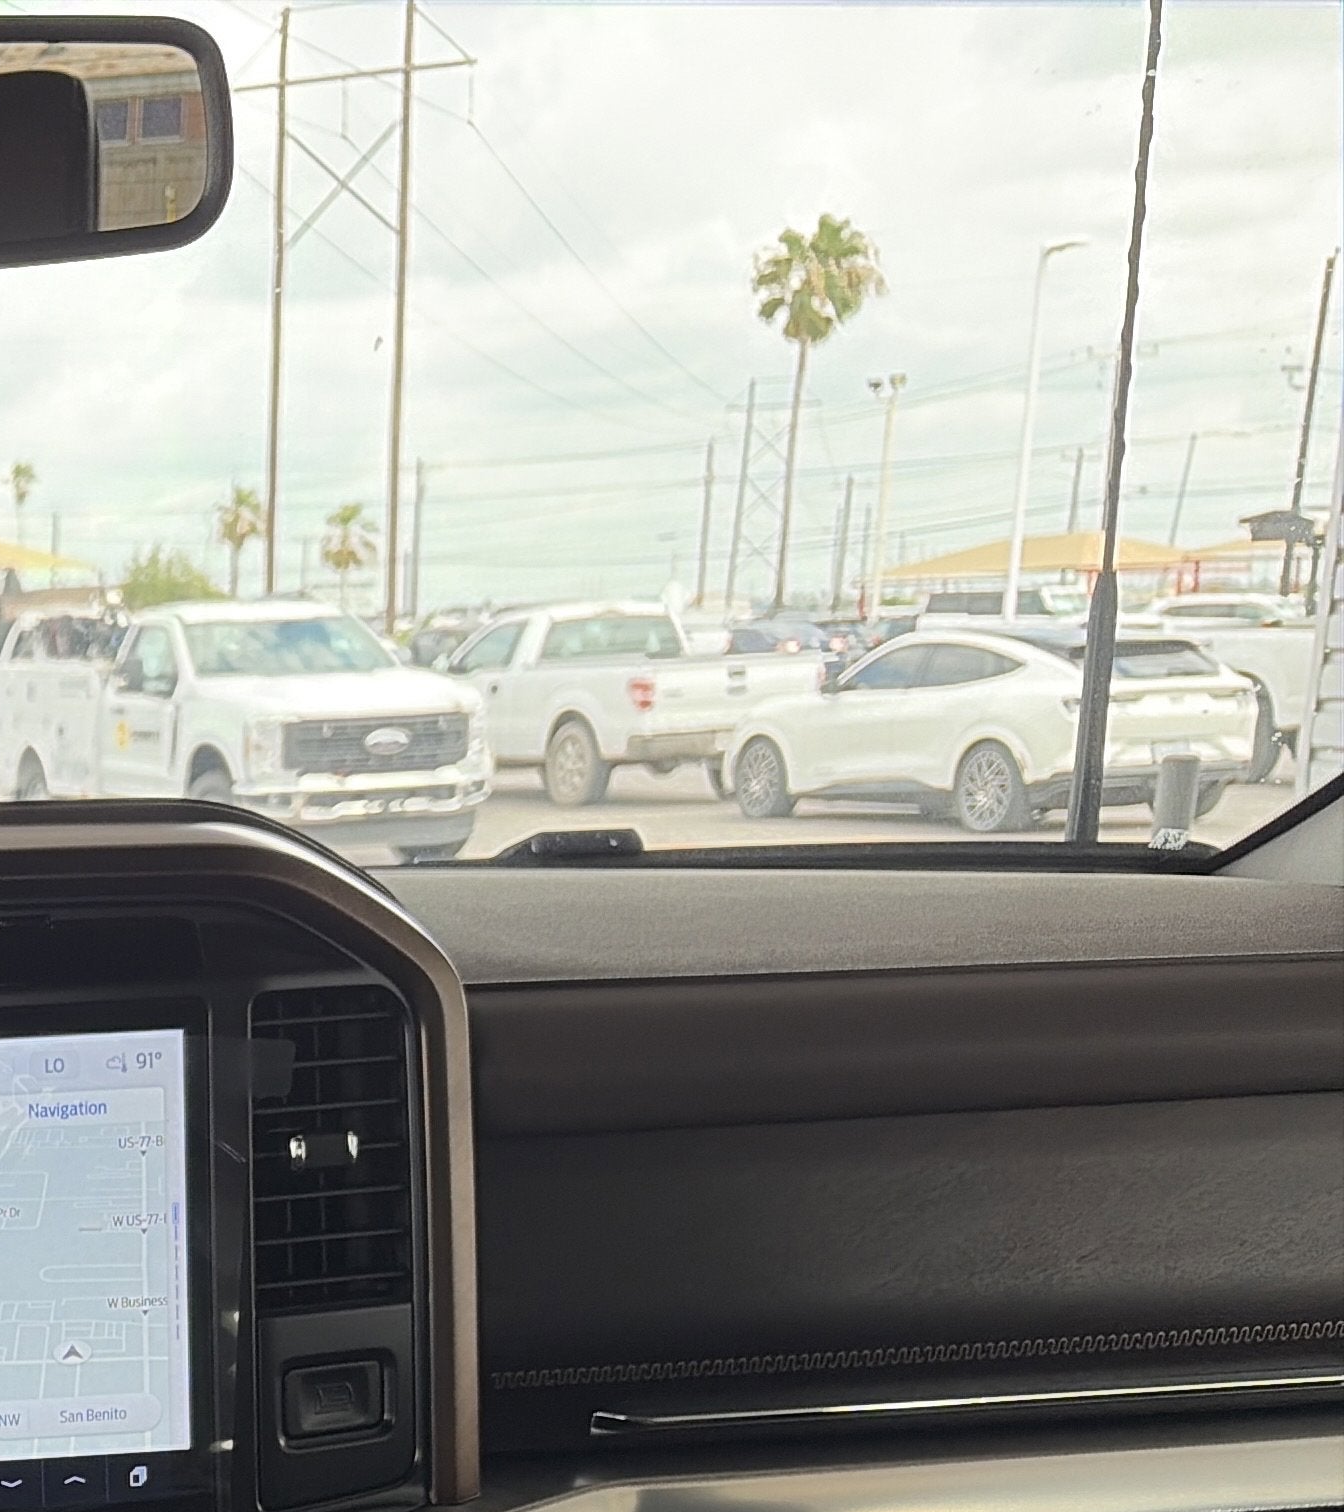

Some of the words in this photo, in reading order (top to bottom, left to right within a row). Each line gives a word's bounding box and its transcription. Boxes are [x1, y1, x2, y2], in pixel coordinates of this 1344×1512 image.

[45, 1058, 65, 1074] LO
[28, 1101, 108, 1120] Navigation
[113, 1216, 124, 1227] W
[107, 1298, 119, 1308] W
[120, 1296, 169, 1309] Business
[59, 1409, 83, 1424] San
[86, 1407, 127, 1423] Benito
